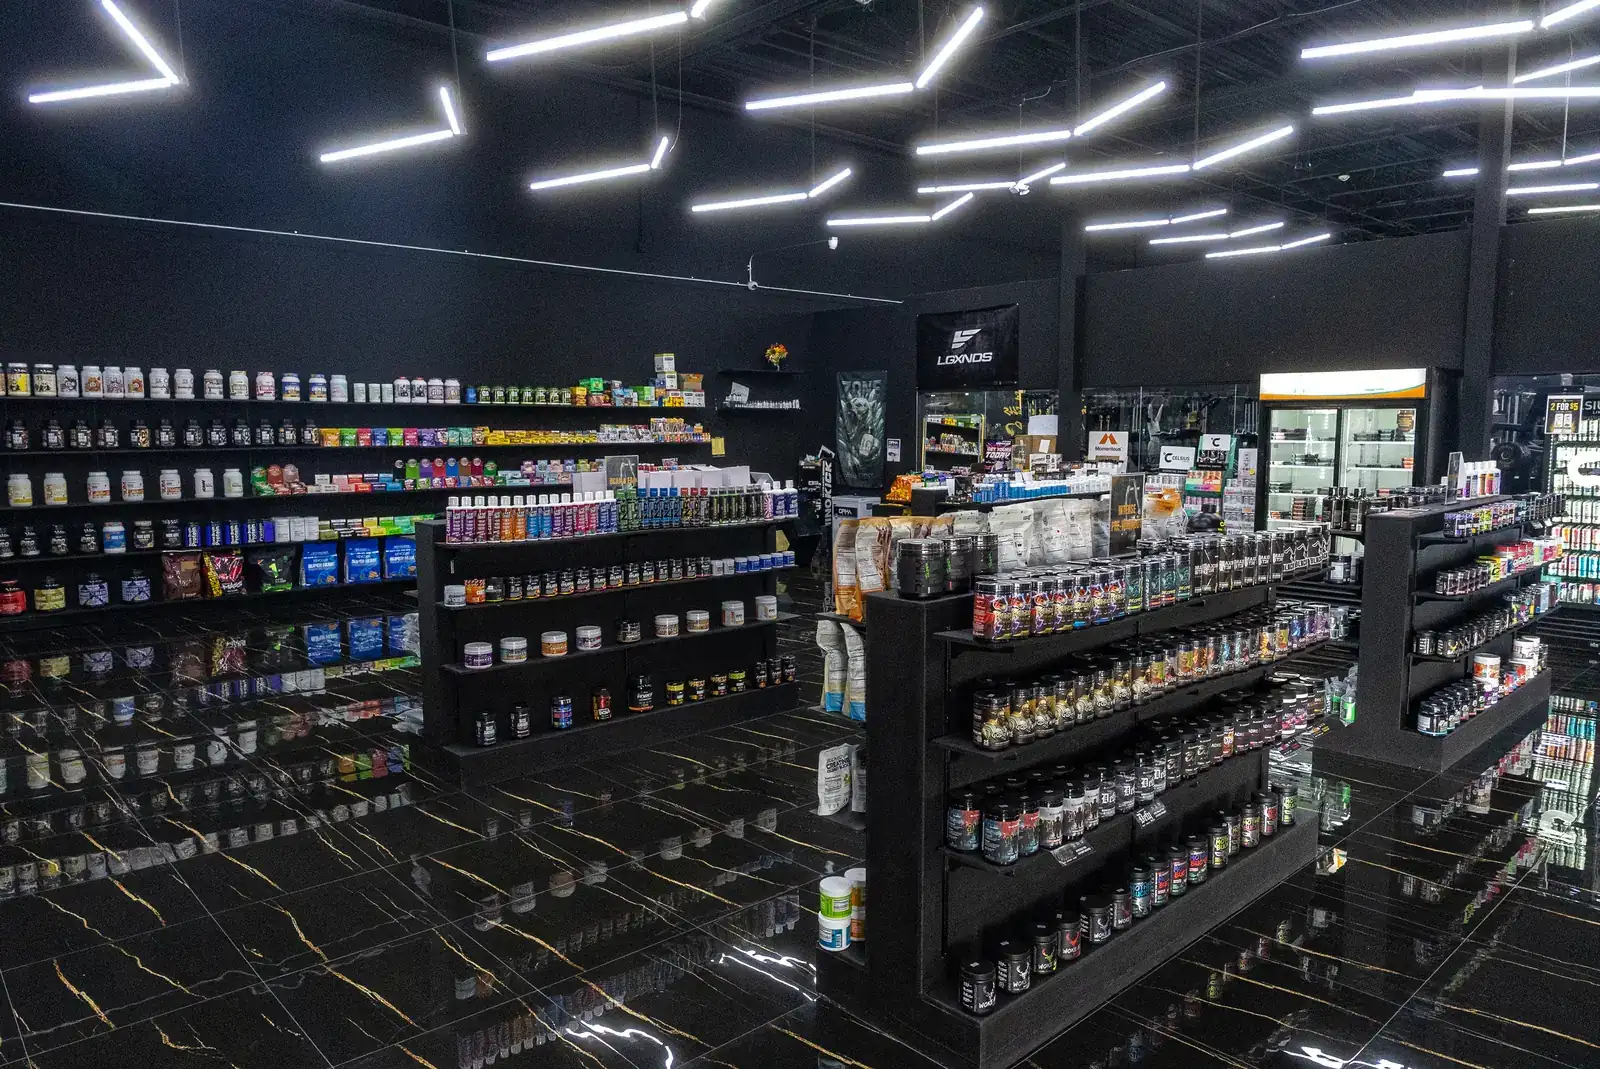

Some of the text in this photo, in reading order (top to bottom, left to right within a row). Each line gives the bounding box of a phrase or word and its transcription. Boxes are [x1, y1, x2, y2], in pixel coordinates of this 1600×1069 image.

[937, 352, 993, 366] LGXNDS
[1550, 402, 1578, 411] 2 FOR $5
[985, 451, 1011, 459] TODAY
